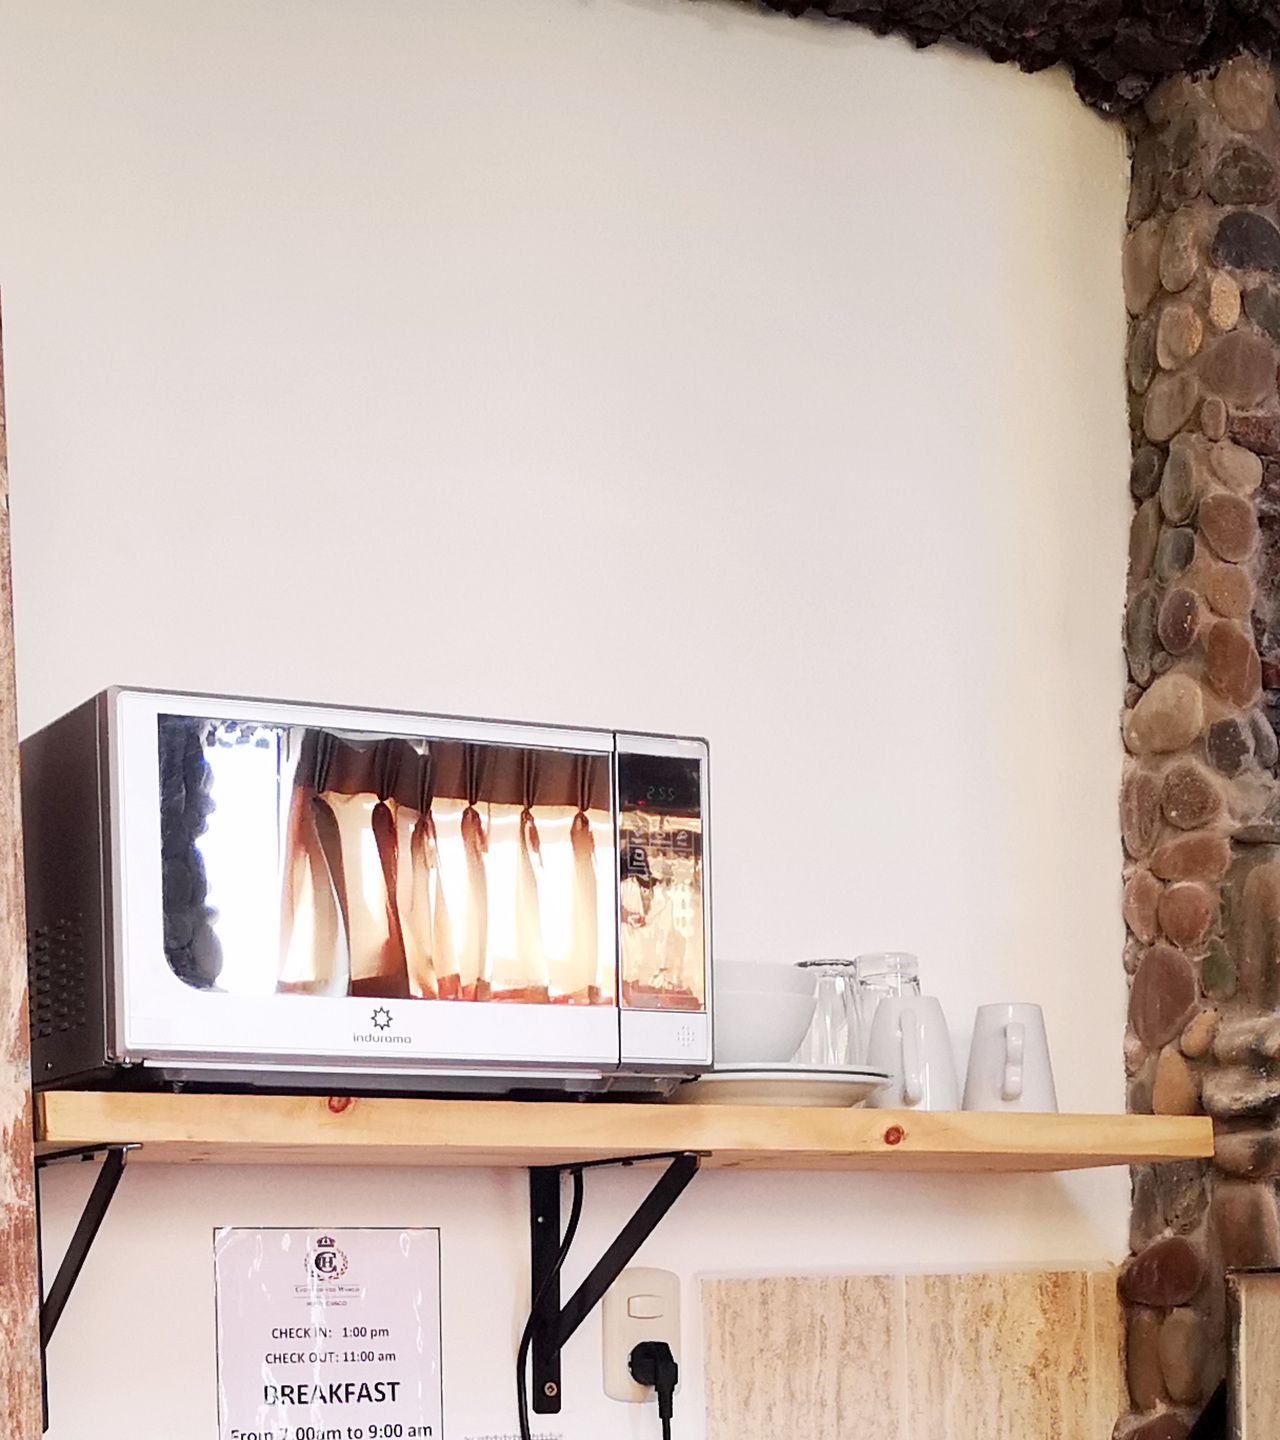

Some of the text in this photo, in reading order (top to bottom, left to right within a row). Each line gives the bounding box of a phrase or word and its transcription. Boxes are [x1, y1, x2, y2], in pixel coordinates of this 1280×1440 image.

[352, 1033, 412, 1044] indurama
[271, 1327, 389, 1340] CHECK IN: 1:00 pm
[265, 1351, 397, 1364] CHECK OUT: 11:00 am
[263, 1382, 401, 1405] BREAKFAST
[347, 1427, 363, 1440] to
[368, 1424, 403, 1439] 9:00
[407, 1425, 433, 1438] am
